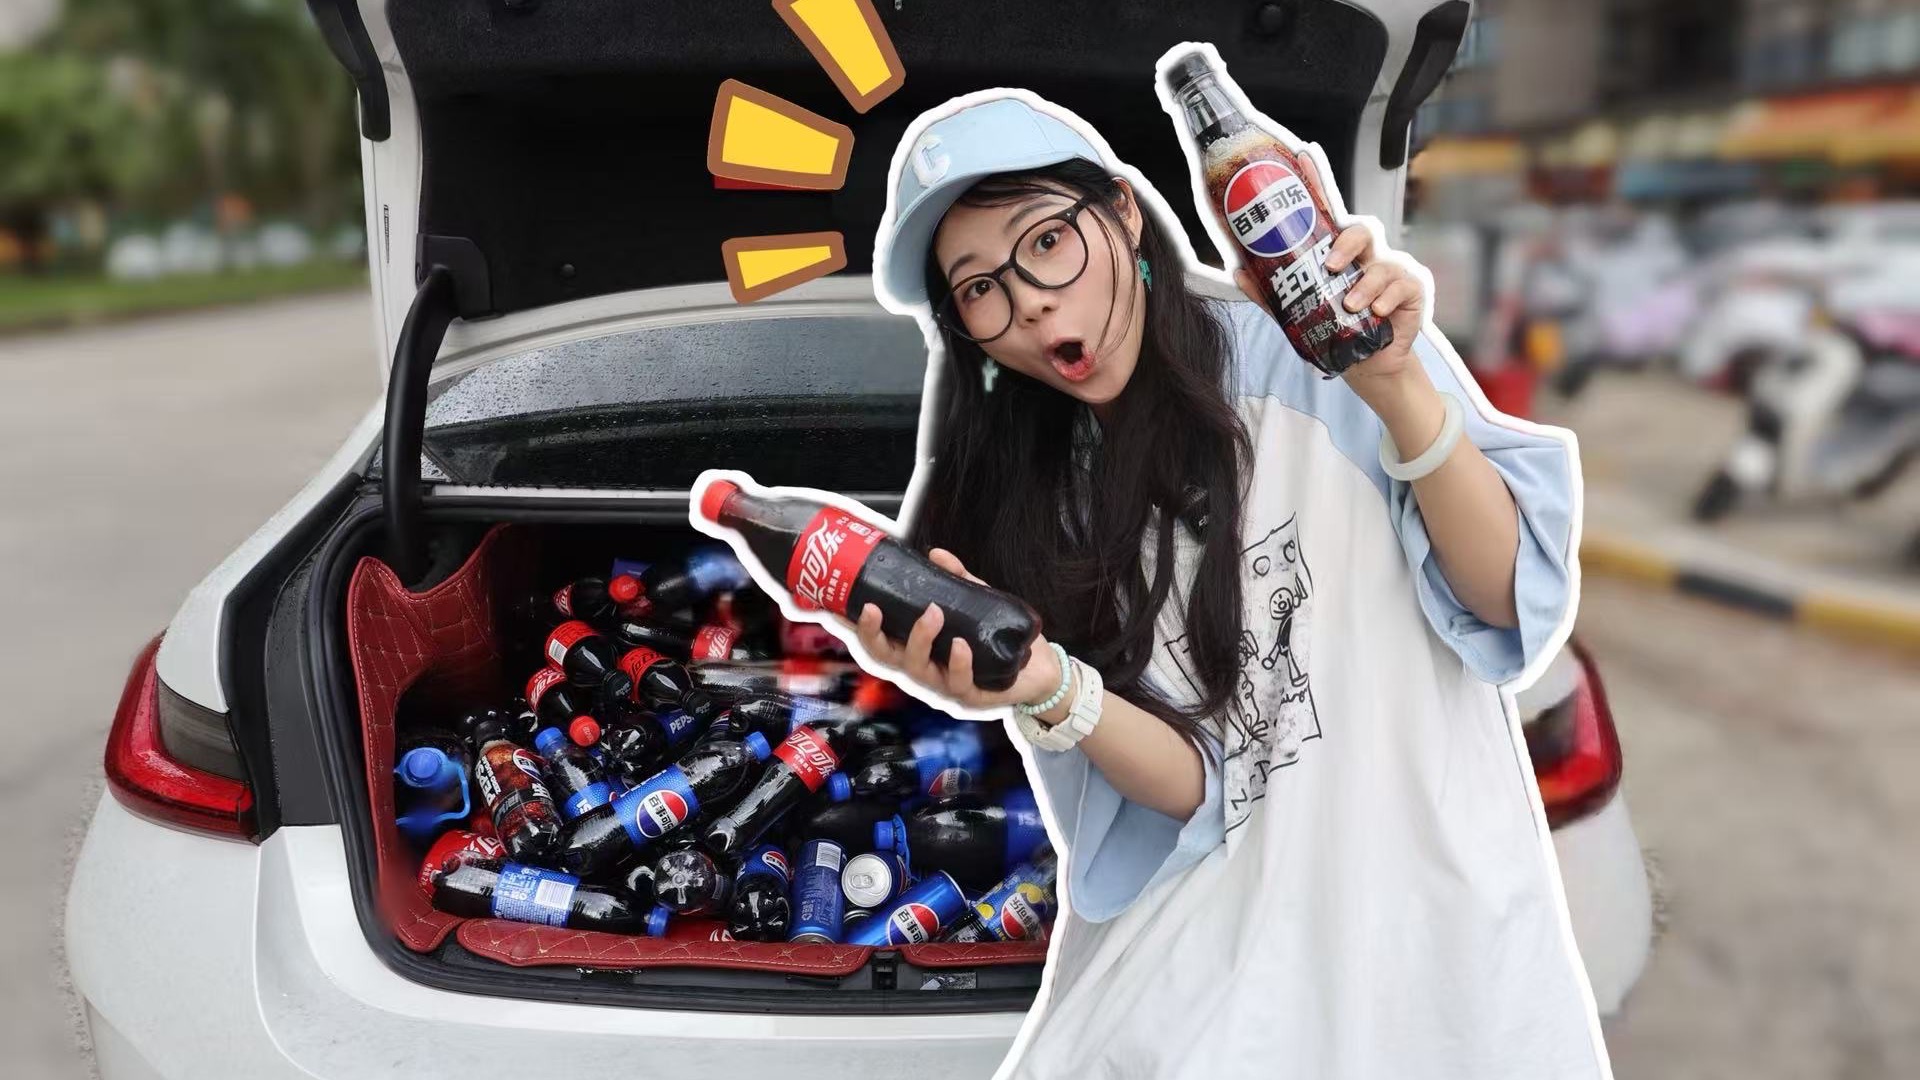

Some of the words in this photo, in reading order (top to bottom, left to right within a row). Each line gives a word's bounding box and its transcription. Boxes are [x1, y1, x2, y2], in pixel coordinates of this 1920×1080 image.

[1232, 184, 1307, 236] 百事可乐
[796, 517, 846, 607] 口可乐
[786, 731, 836, 779] 可口可乐
[648, 795, 674, 833] 百事可乐
[898, 909, 925, 944] 百事可
